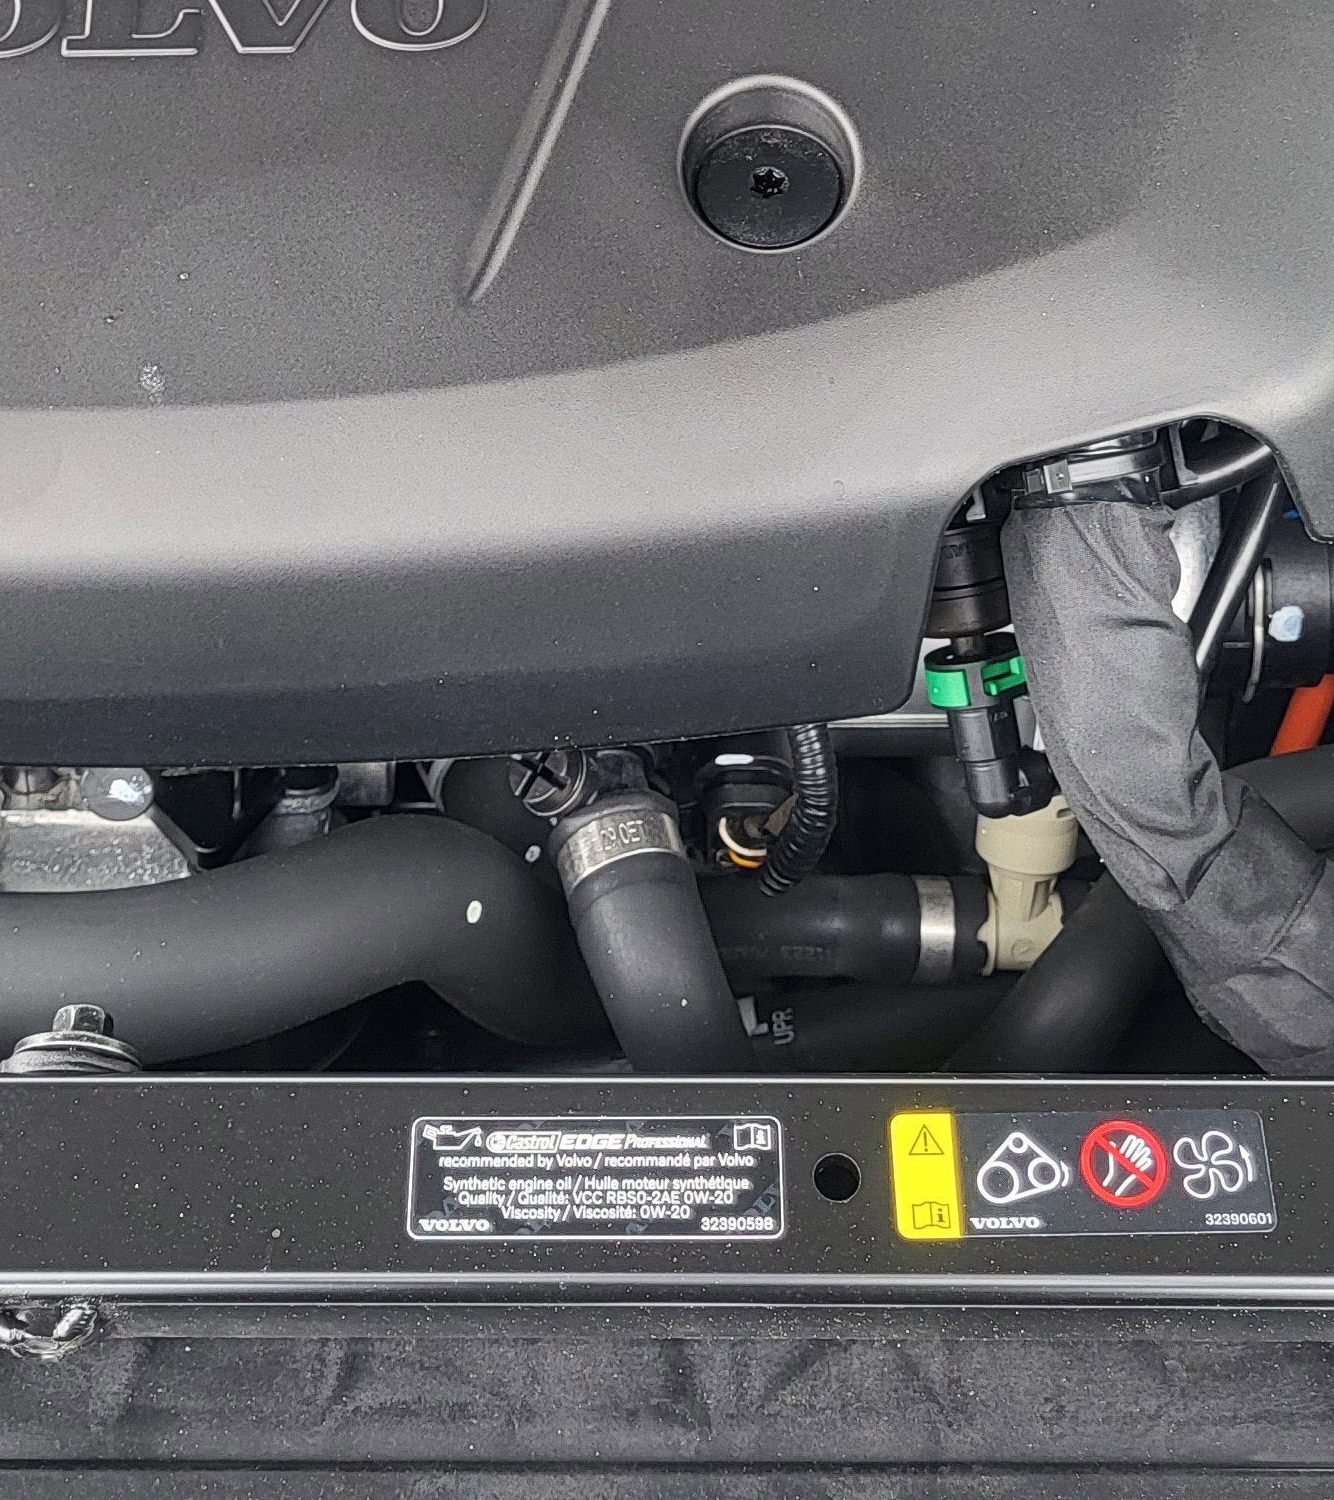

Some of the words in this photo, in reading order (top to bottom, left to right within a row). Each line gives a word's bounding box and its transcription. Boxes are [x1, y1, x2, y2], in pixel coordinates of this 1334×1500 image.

[505, 1134, 556, 1150] Castrol
[558, 1133, 625, 1150] EDGE
[438, 1153, 534, 1168] recommended
[537, 1153, 554, 1170] by
[556, 1153, 593, 1168] Volvo
[593, 1152, 603, 1169] /
[604, 1152, 691, 1167] recommandé
[693, 1156, 716, 1170] par
[717, 1152, 754, 1167] Volvo
[443, 1175, 506, 1194] Synthetic
[508, 1175, 553, 1193] engine
[555, 1175, 572, 1190] oil
[573, 1174, 582, 1191] /
[584, 1175, 619, 1190] Huile
[621, 1176, 669, 1190] moteur
[672, 1175, 750, 1195] synthétique
[458, 1190, 506, 1208] Quality
[506, 1190, 516, 1207] /
[518, 1190, 569, 1205] Qualité:
[572, 1190, 603, 1205] VCC
[606, 1190, 680, 1204] RBS0-2AE
[683, 1190, 734, 1204] 0W-20
[501, 1205, 561, 1222] Viscosity
[562, 1204, 571, 1221] /
[572, 1205, 637, 1219] Viscosité:
[640, 1205, 690, 1219] 0W-20
[969, 1216, 1040, 1229] VOLVO
[1205, 1212, 1273, 1226] 32390601
[418, 1218, 490, 1232] VOLVO
[700, 1216, 774, 1231] 32390598
